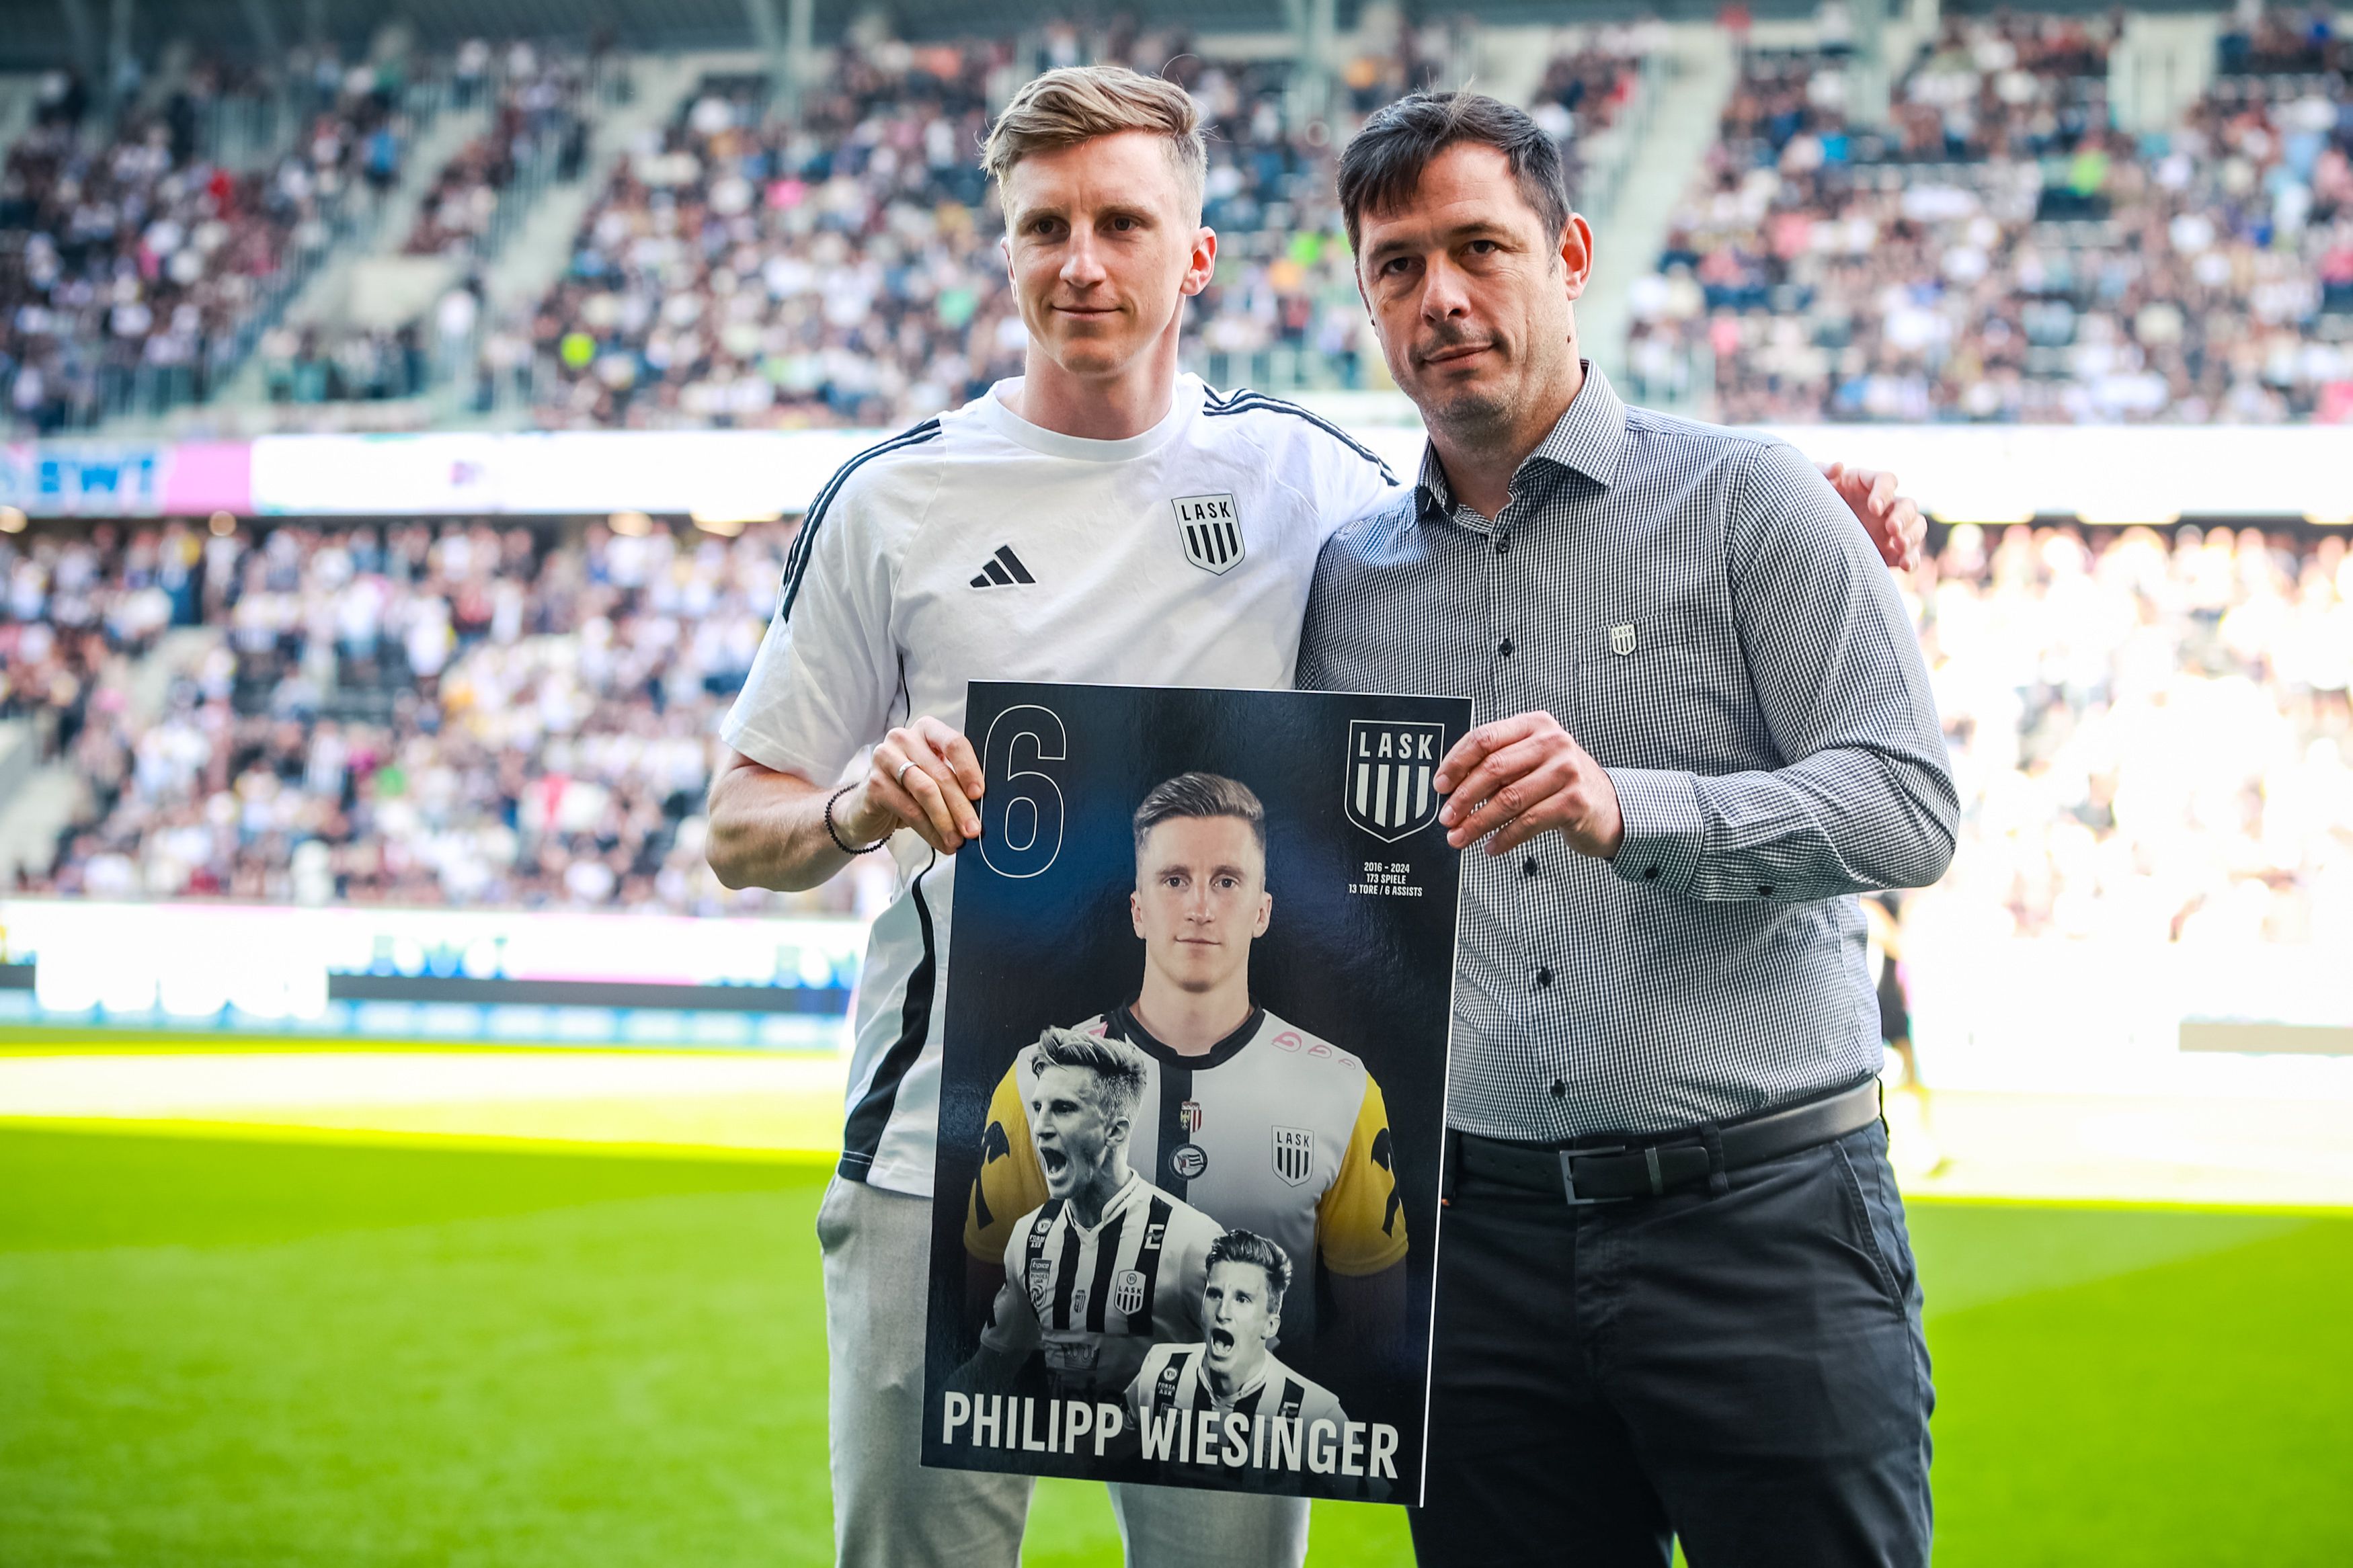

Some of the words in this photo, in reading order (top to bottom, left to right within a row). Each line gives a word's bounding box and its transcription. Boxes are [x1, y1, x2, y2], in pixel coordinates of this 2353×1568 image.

[1181, 501, 1232, 521] LASK
[1613, 627, 1633, 636] LASK
[1359, 731, 1433, 760] LASK
[979, 704, 1067, 878] 6
[1364, 862, 1383, 872] 2016
[1390, 863, 1410, 874] 2024
[1366, 873, 1379, 884] 173
[1380, 874, 1406, 884] SPIELE
[1349, 884, 1357, 894] 13
[1359, 884, 1378, 895] TORE
[1385, 885, 1390, 895] 6
[1392, 886, 1423, 897] ASSISTS
[1277, 1131, 1310, 1148] LASK
[1118, 1285, 1142, 1295] LASK
[943, 1391, 1123, 1456] PHILIPP
[1140, 1406, 1399, 1479] WIESINGER
